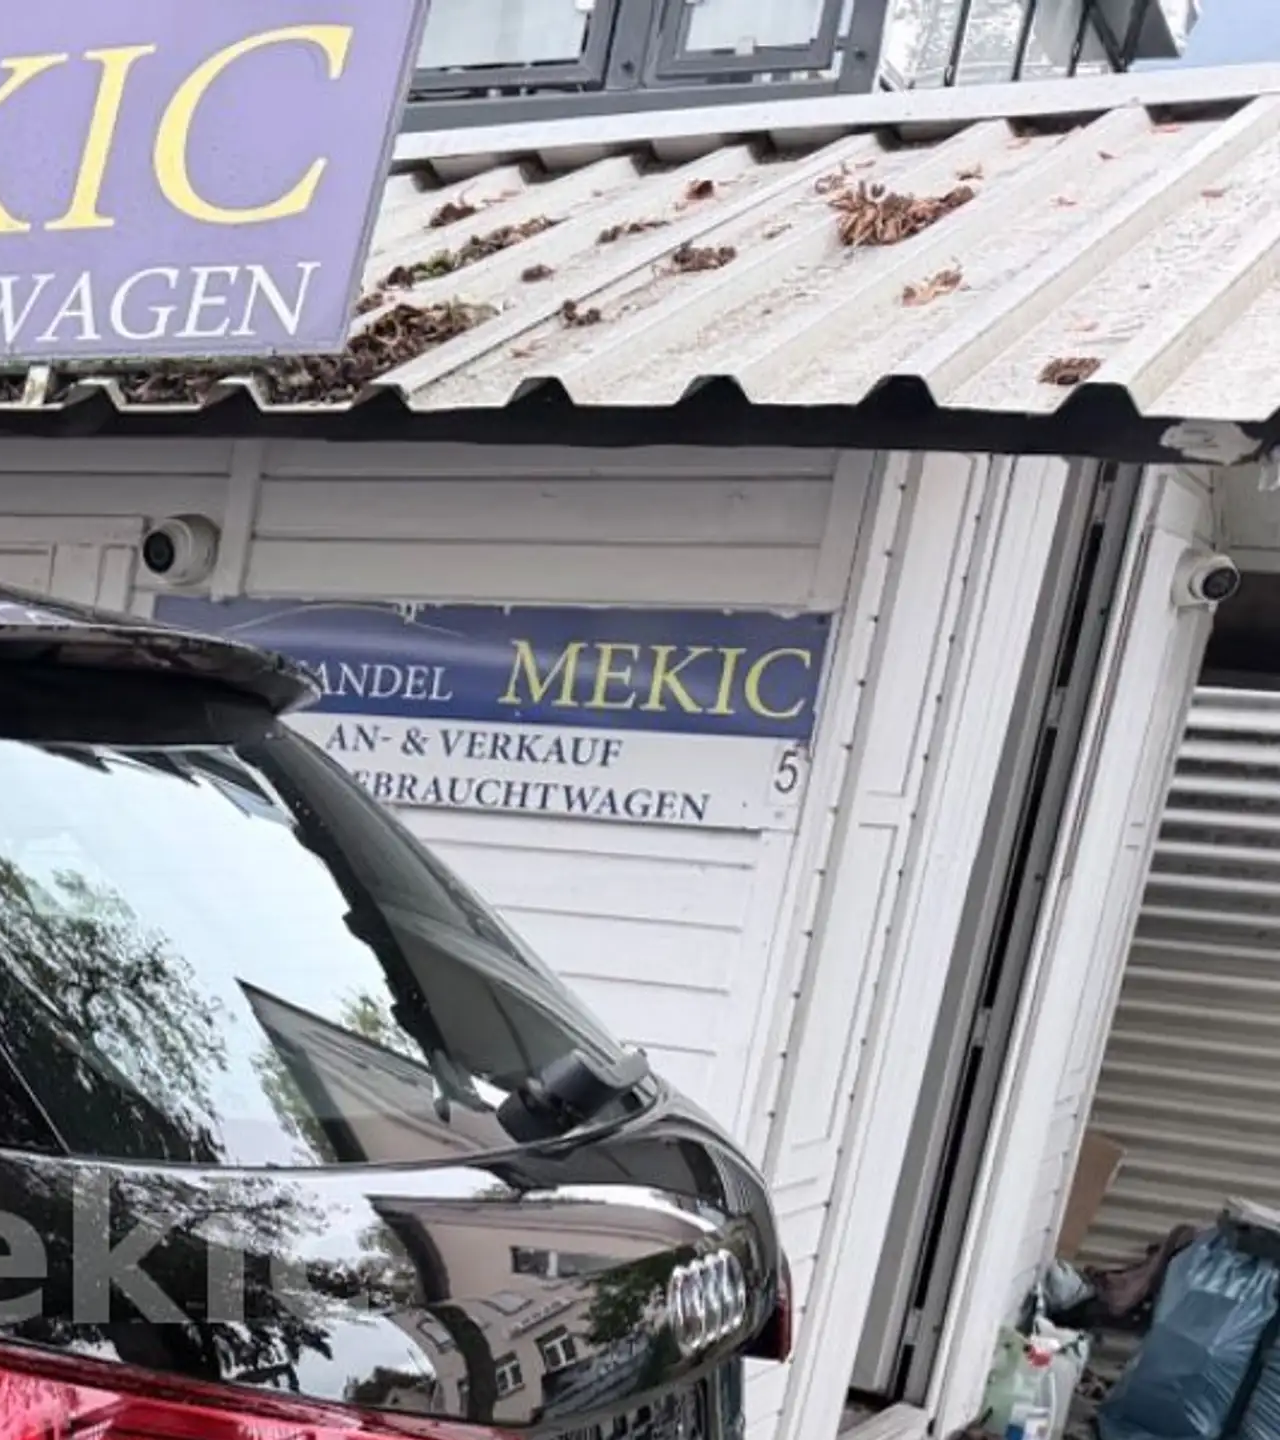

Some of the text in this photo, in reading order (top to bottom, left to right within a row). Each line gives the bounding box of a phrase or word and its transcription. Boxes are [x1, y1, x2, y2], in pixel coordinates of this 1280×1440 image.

[297, 640, 811, 719] ANDEL MEKIC
[326, 722, 624, 768] AN- & VERKAUF
[773, 749, 799, 794] 5
